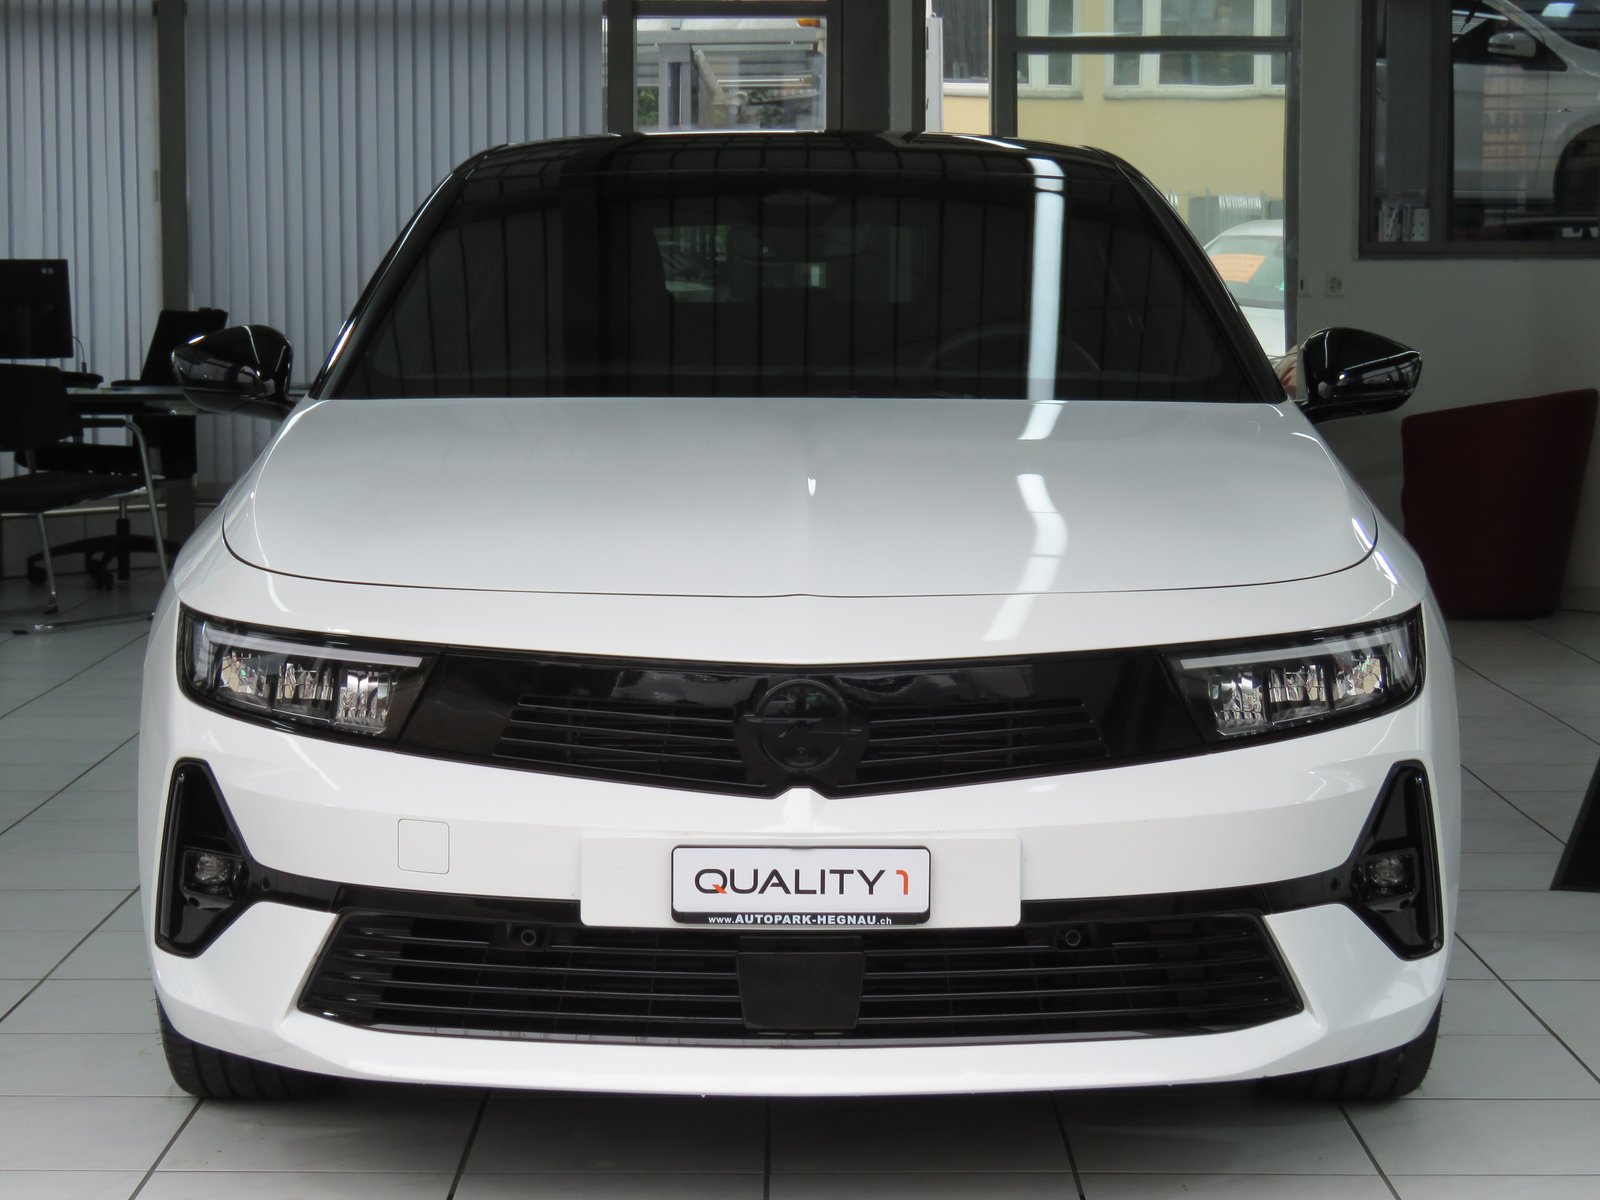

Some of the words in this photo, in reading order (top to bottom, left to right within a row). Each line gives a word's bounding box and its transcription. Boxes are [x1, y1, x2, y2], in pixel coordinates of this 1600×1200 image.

[694, 868, 886, 895] QUALITY
[895, 869, 909, 896] 1
[708, 913, 892, 926] www.AUTOPARK-HEGNAU.ch
